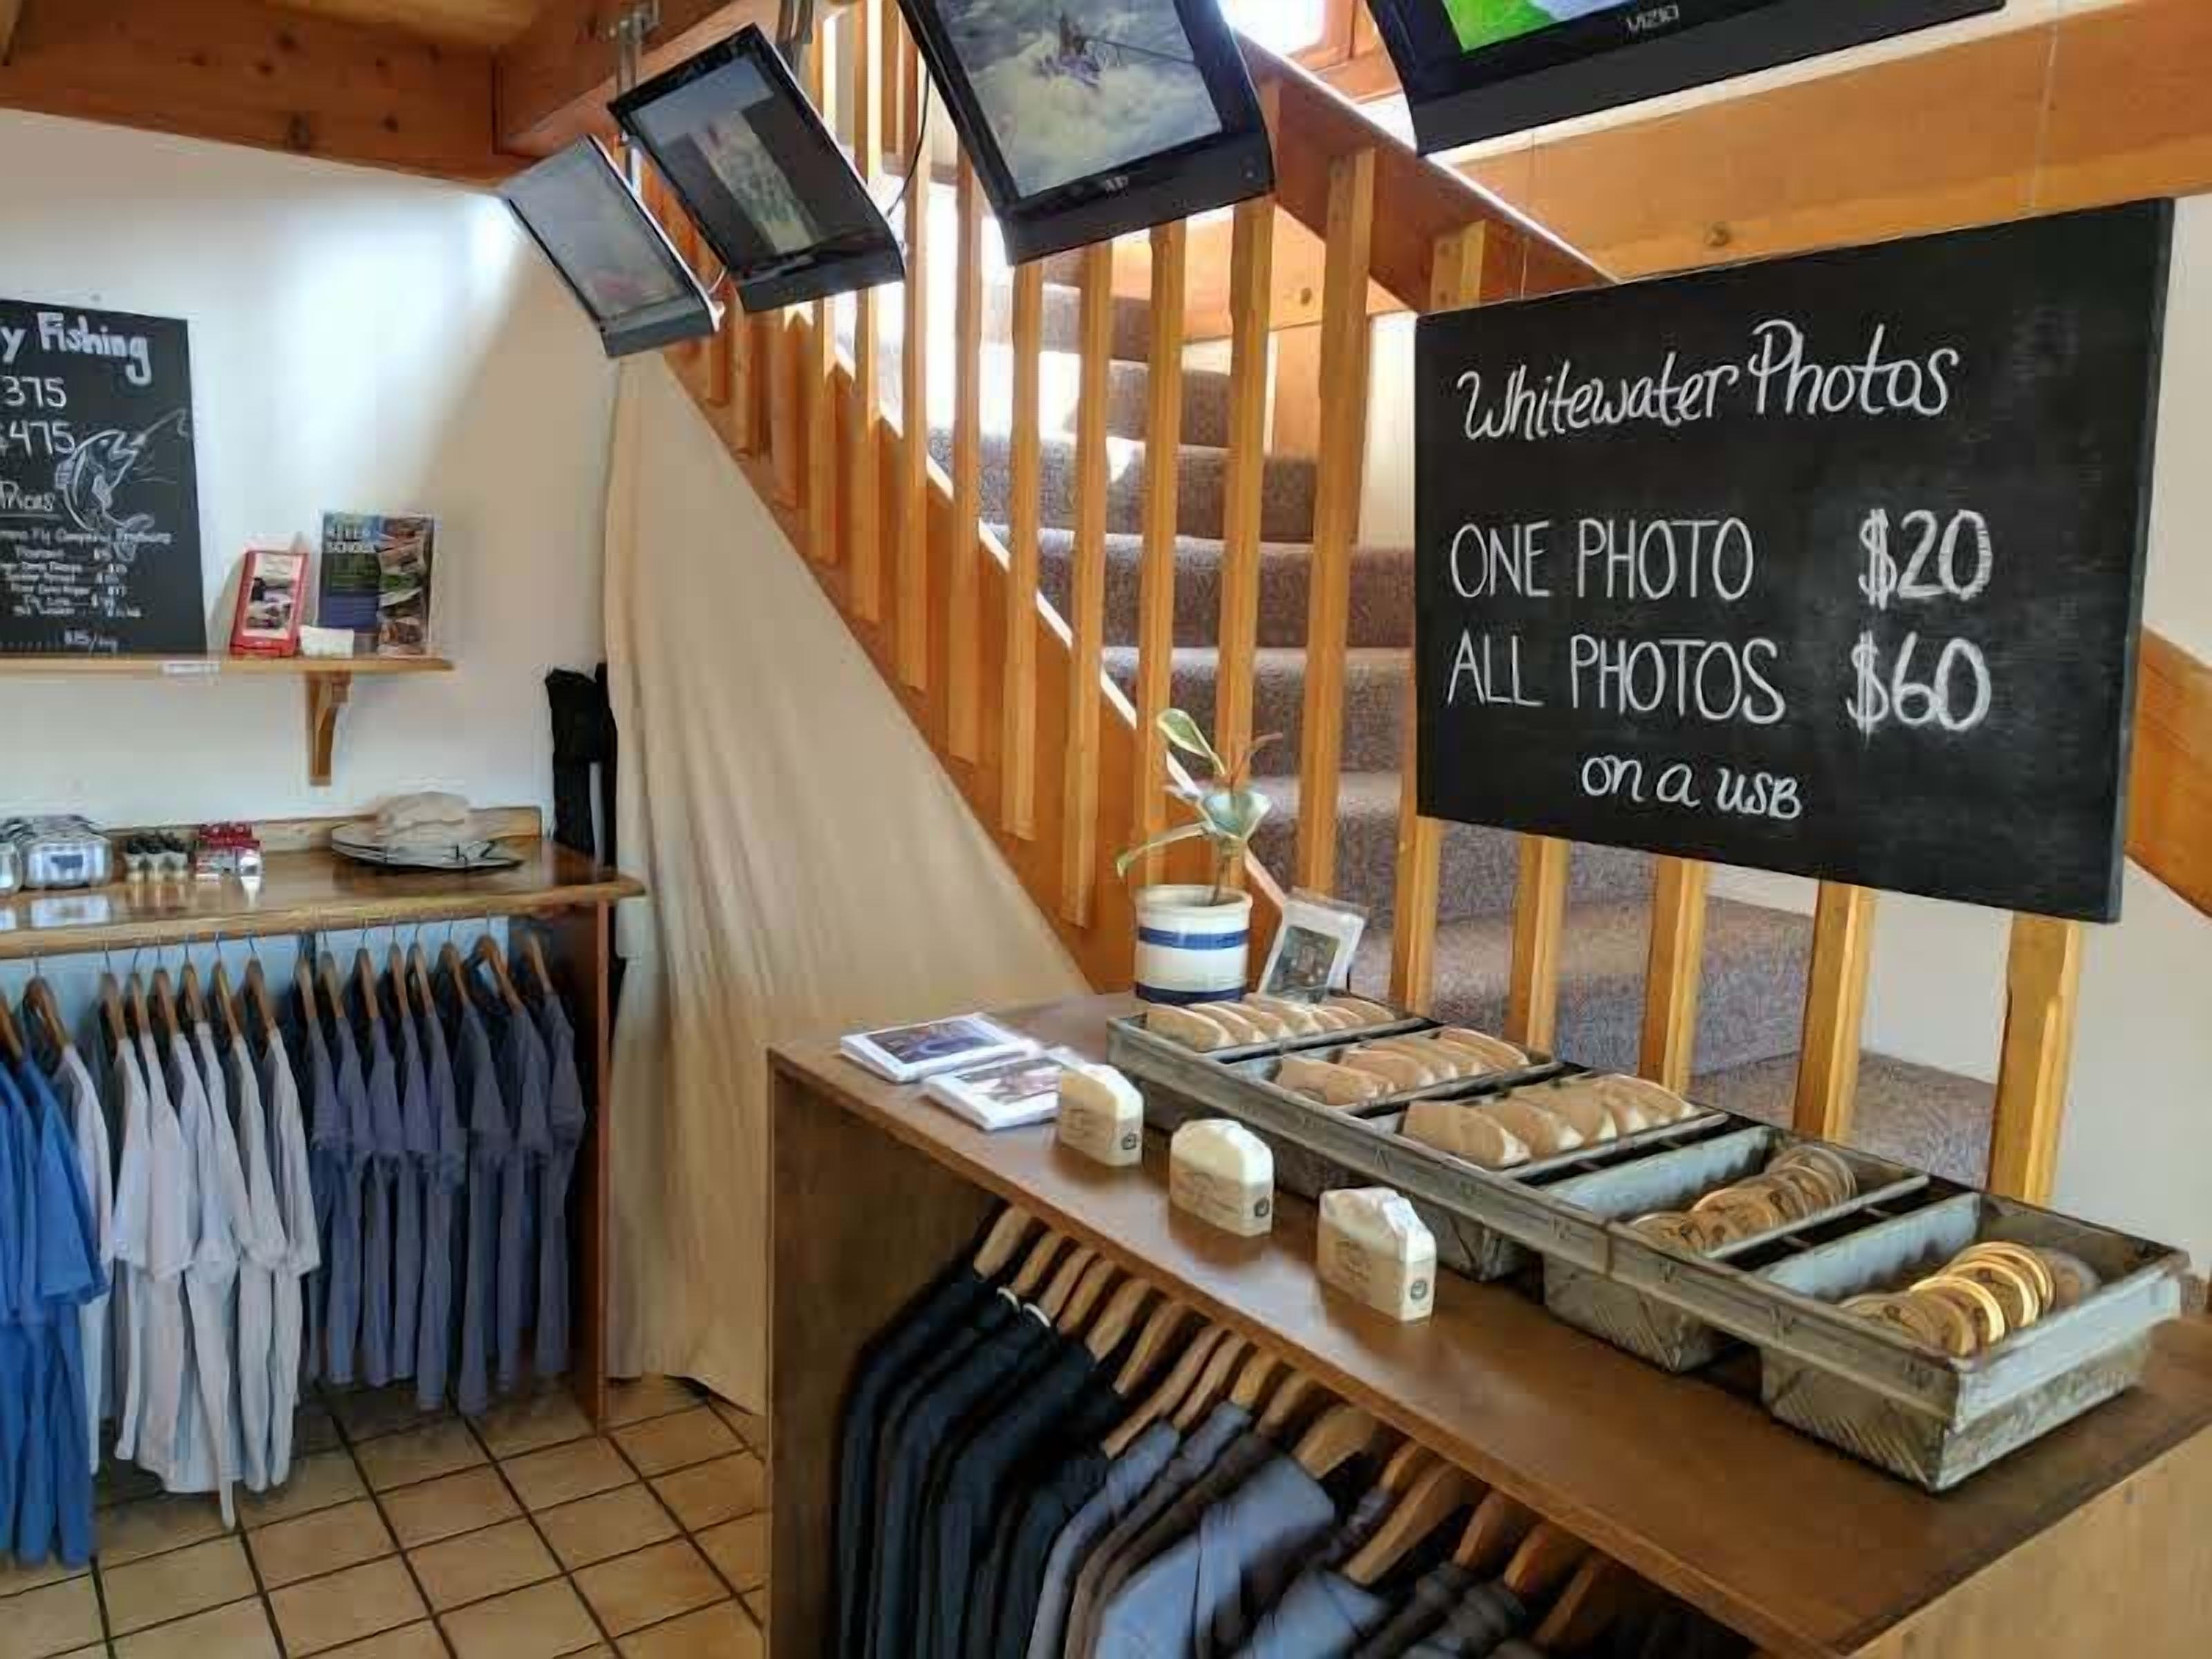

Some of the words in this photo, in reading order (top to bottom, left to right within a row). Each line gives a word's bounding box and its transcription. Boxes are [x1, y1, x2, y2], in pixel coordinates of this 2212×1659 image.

[37, 311, 152, 386] Fishing
[1456, 351, 1737, 441] Whitewater
[1747, 319, 1960, 416] Photos
[1450, 520, 1551, 599] ONE
[1577, 516, 1754, 601] PHOTO
[1857, 507, 1994, 611] $20
[1447, 629, 1543, 707] ALL
[1570, 633, 1786, 725] PHOTOS
[1846, 629, 1993, 747] $60
[1581, 754, 1645, 803] on
[1656, 763, 1700, 808] a
